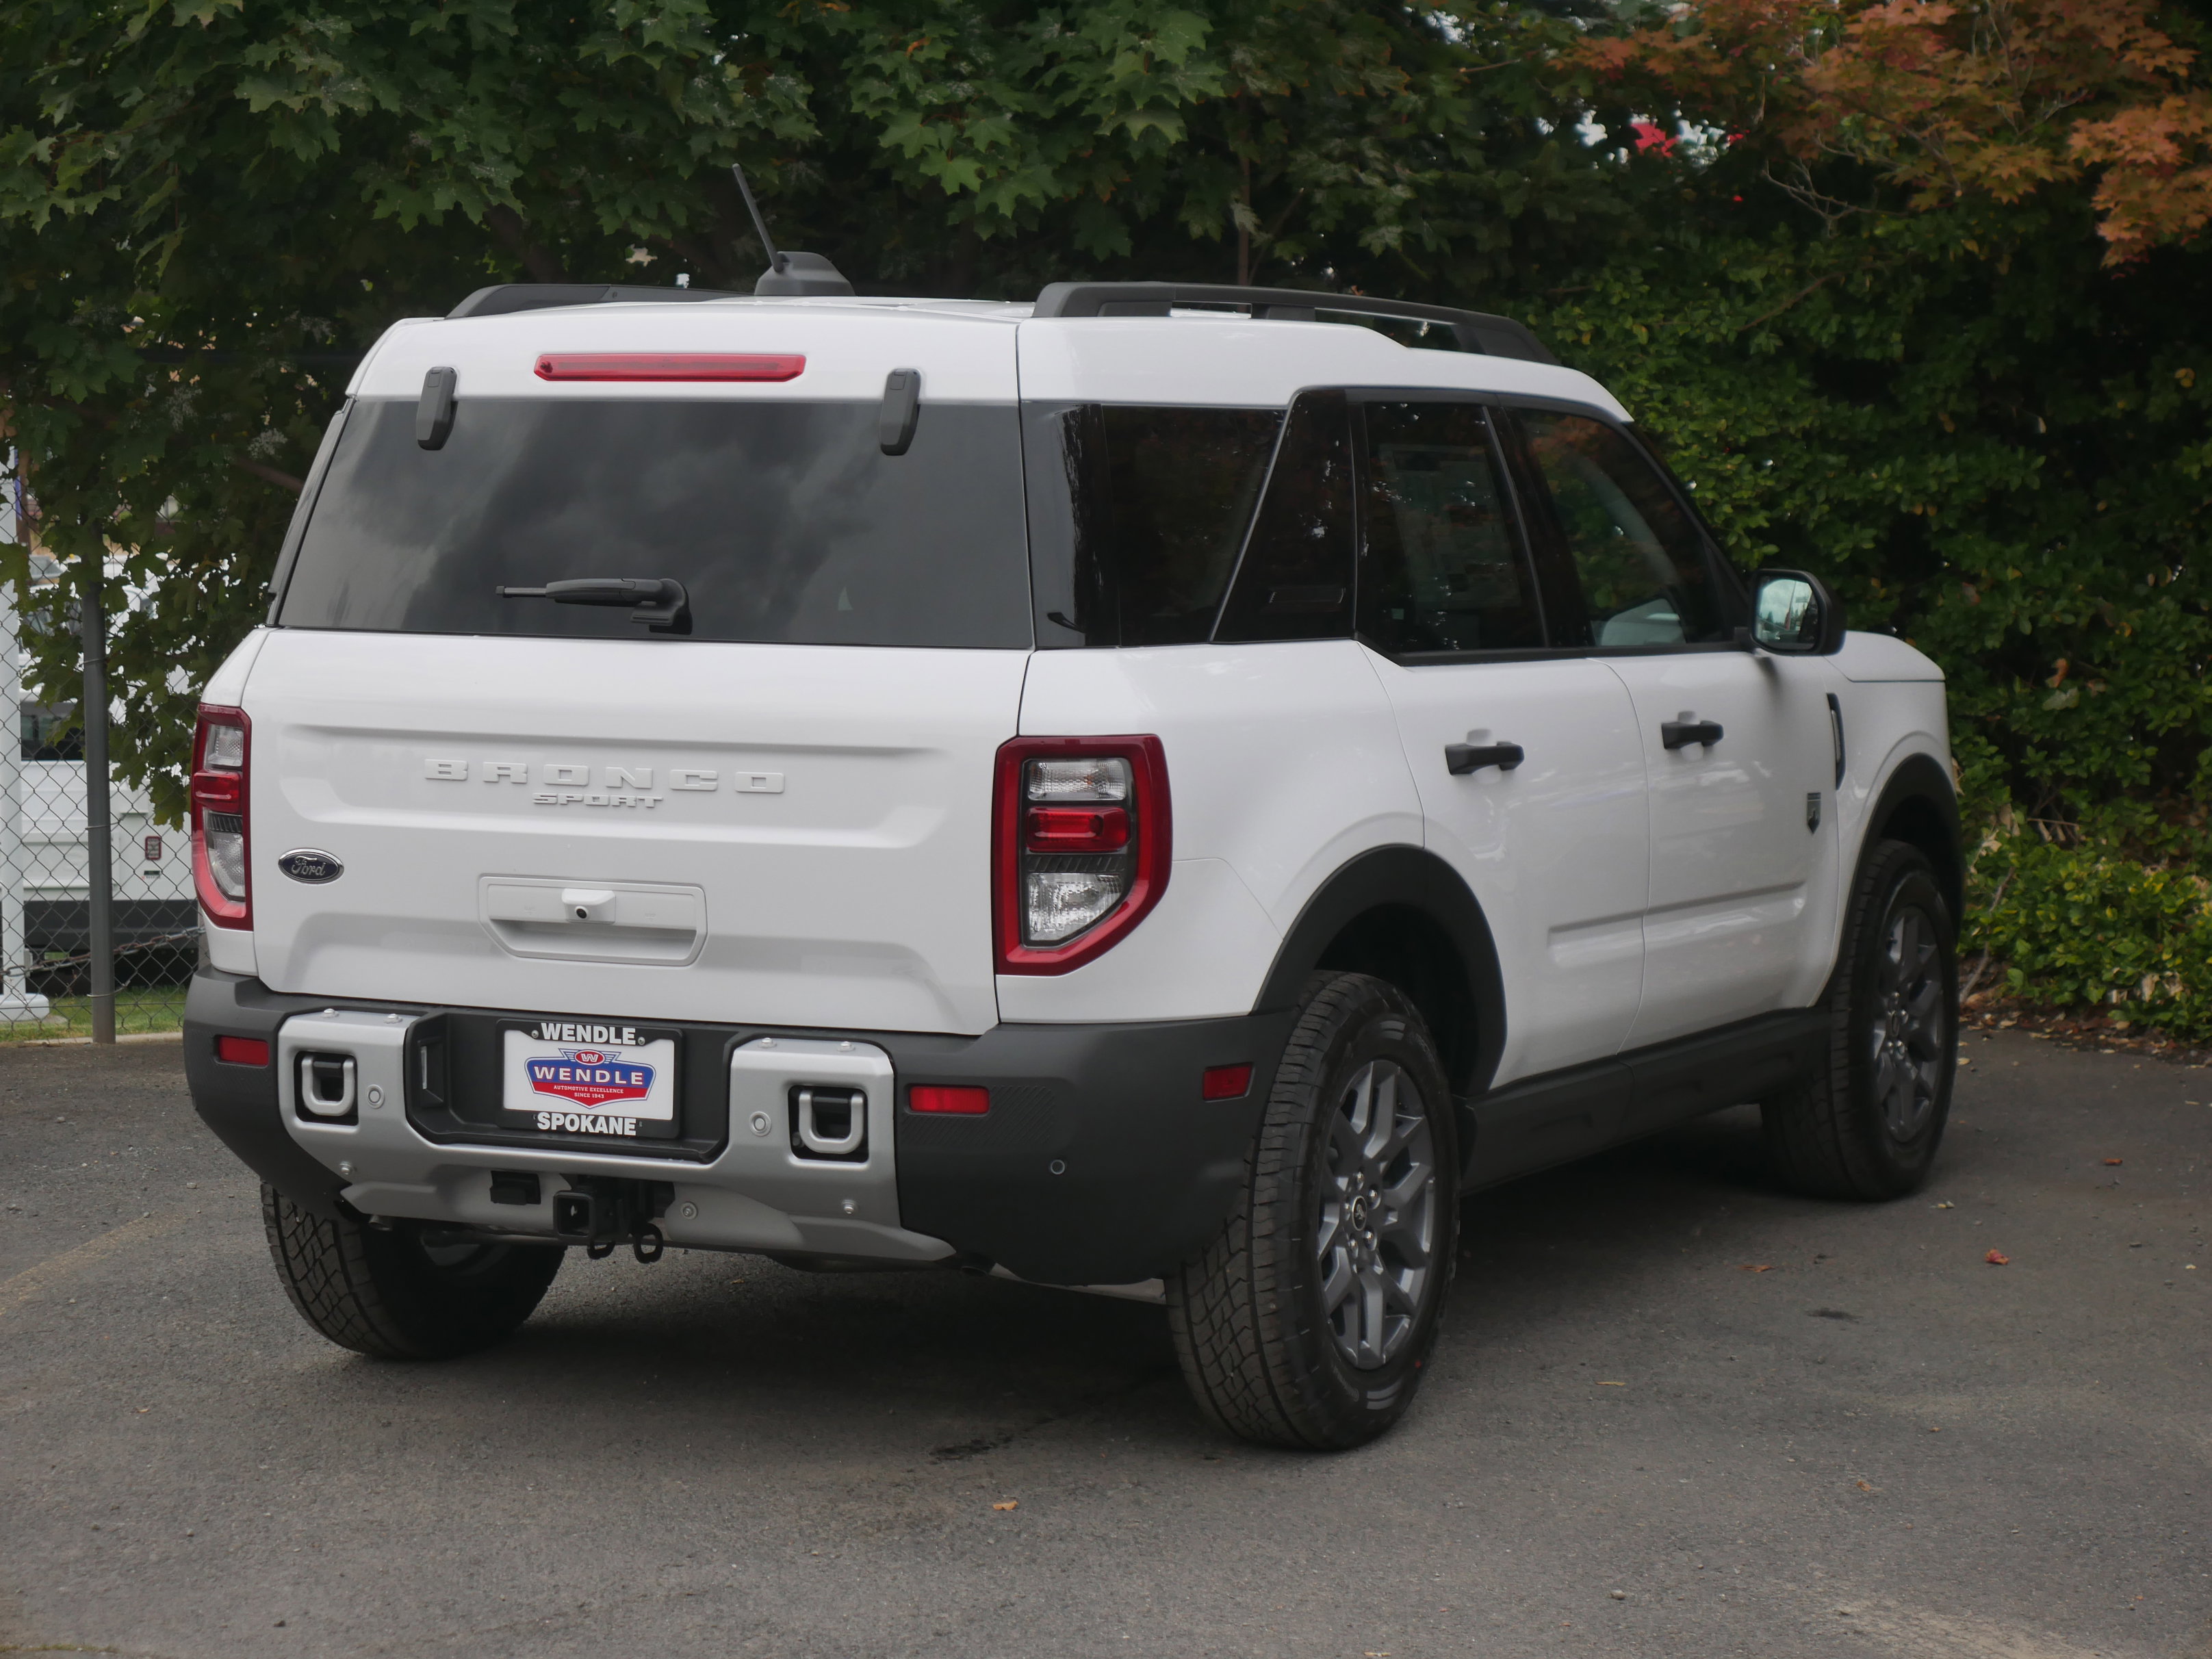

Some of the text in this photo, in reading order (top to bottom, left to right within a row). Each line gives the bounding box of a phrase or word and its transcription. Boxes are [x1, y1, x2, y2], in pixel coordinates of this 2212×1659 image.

[424, 758, 785, 794] BRONCO
[532, 792, 663, 808] SPORT
[291, 856, 326, 876] Ford
[541, 1023, 636, 1045] WENDLE
[534, 1066, 643, 1085] WENDLE
[537, 1112, 636, 1136] SPOKANE
